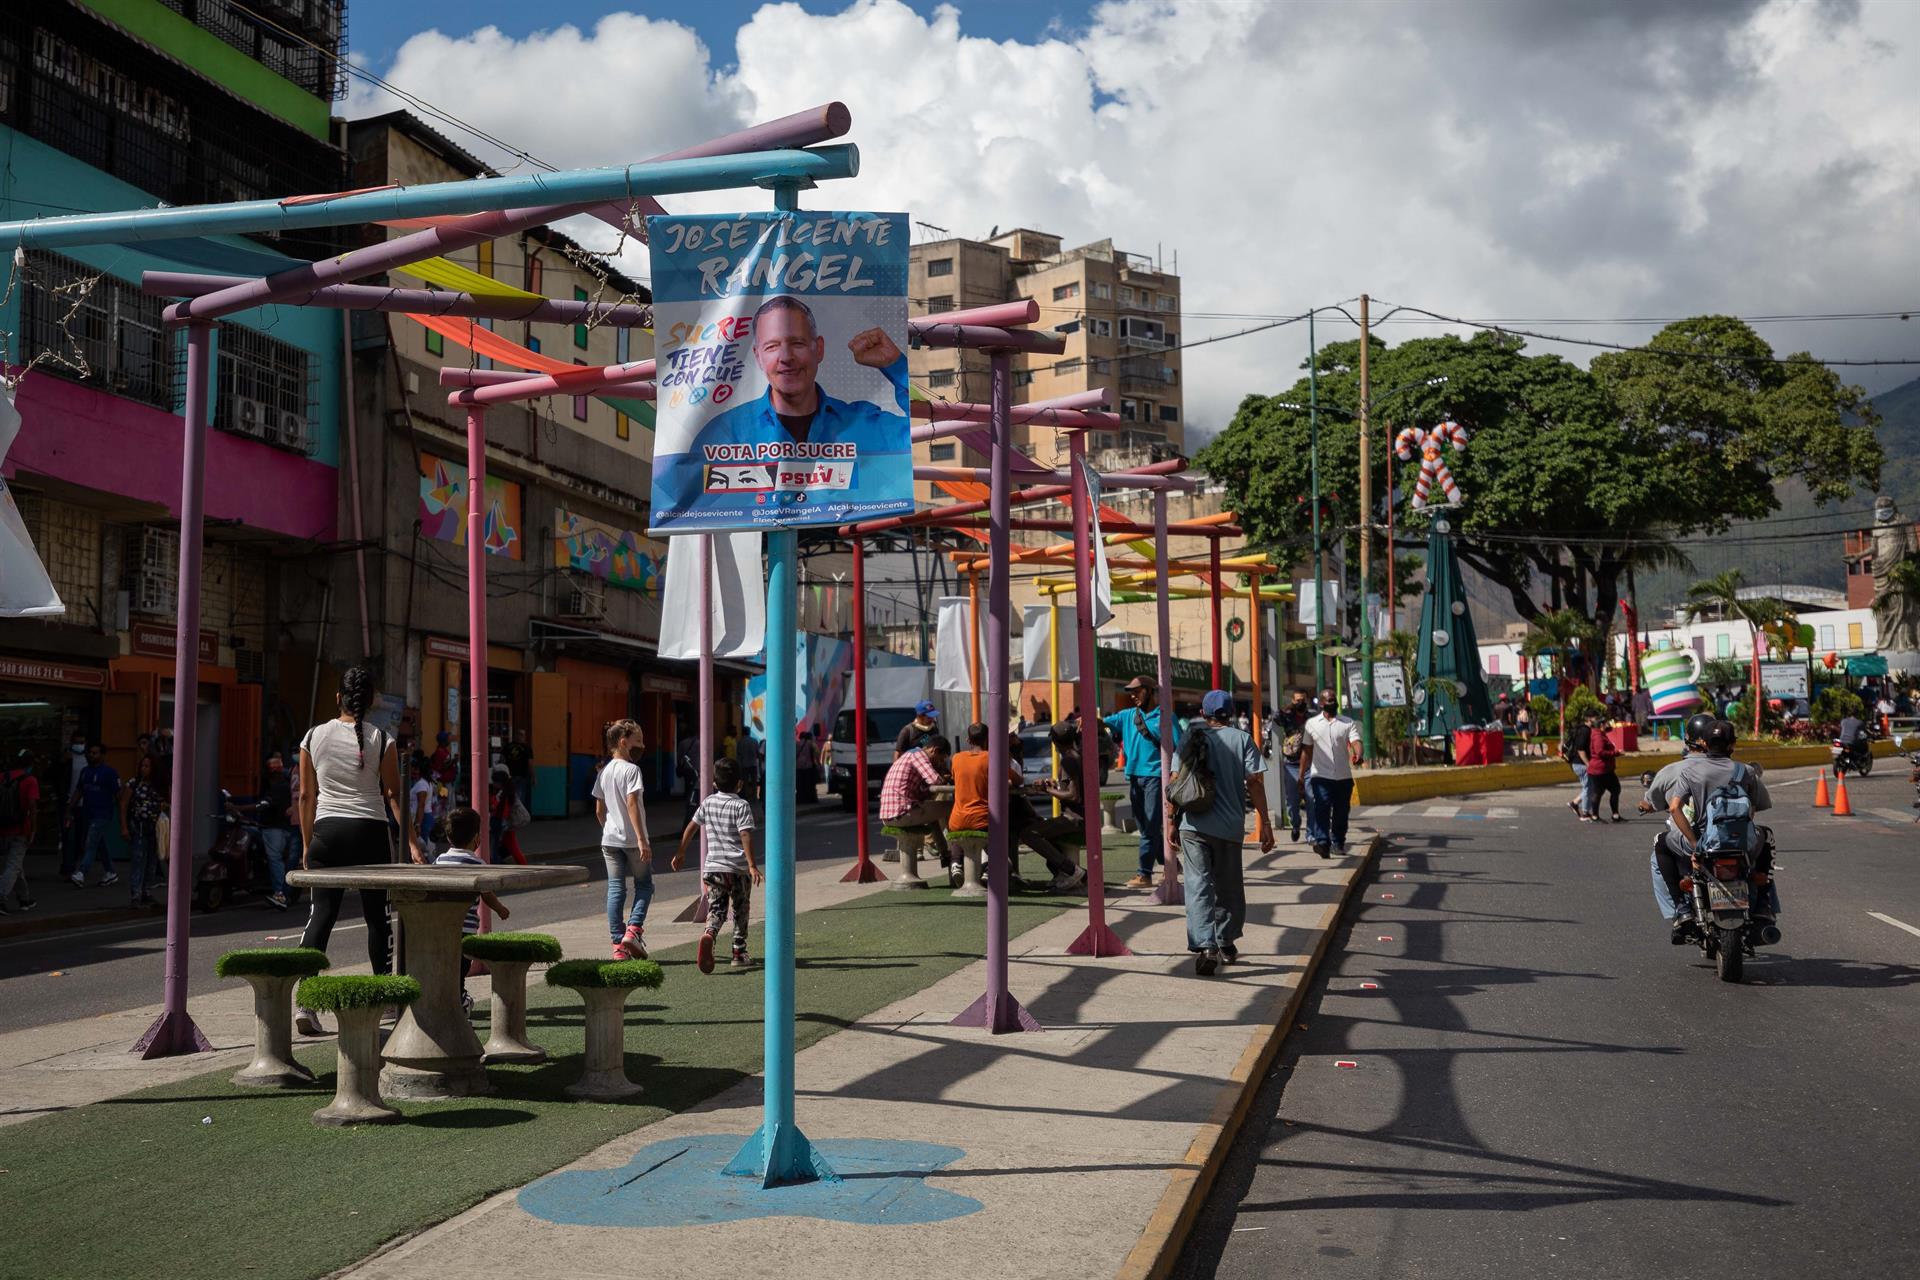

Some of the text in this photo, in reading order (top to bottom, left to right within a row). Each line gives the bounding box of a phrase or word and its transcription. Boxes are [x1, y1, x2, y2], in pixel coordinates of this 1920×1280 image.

[665, 212, 751, 253] JOSÉ
[697, 251, 874, 299] RANGEL
[662, 316, 753, 348] SUCRE
[666, 343, 740, 371] TIENE
[661, 360, 745, 387] CON QUÉ
[704, 443, 857, 460] VOTA POR SUCRE
[751, 506, 822, 518] @JoseVRangelA
